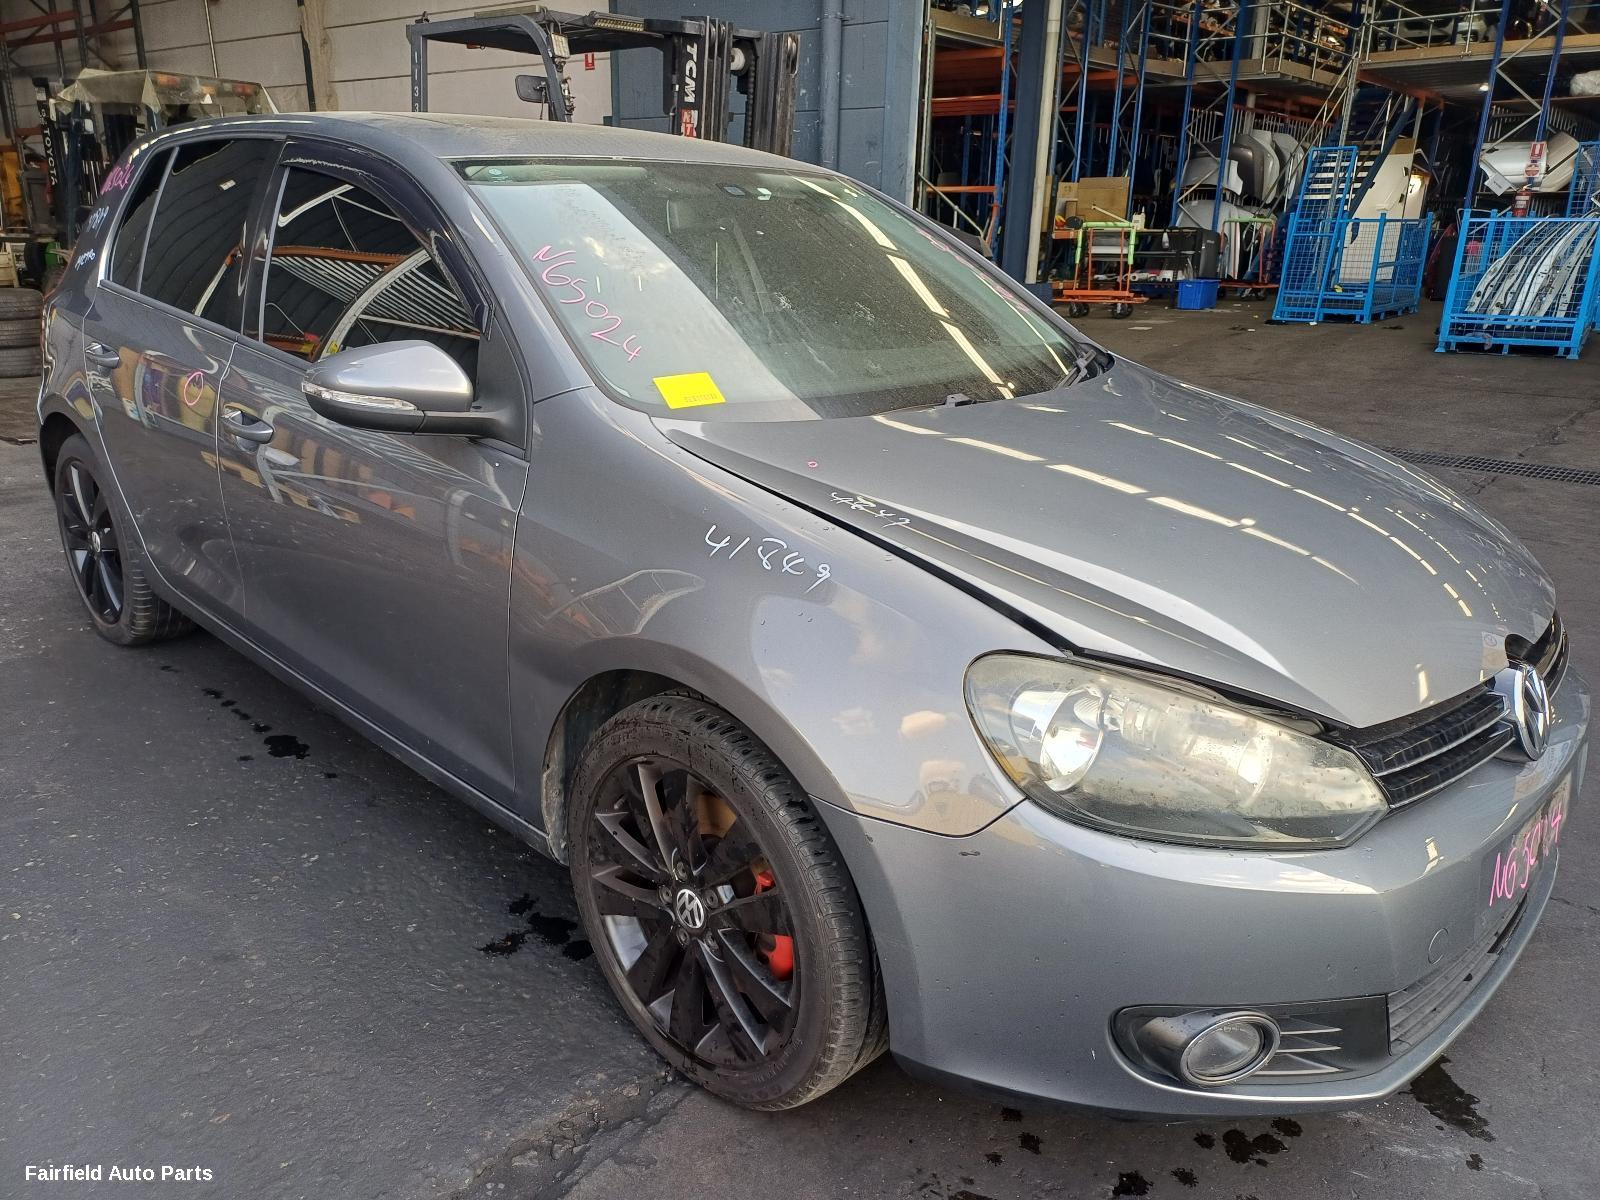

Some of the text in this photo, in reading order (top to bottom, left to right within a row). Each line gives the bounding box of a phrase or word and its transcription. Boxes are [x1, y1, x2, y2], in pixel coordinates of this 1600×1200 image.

[684, 42, 699, 103] TCM
[43, 127, 58, 186] TOYOTA
[704, 524, 831, 594] 41849
